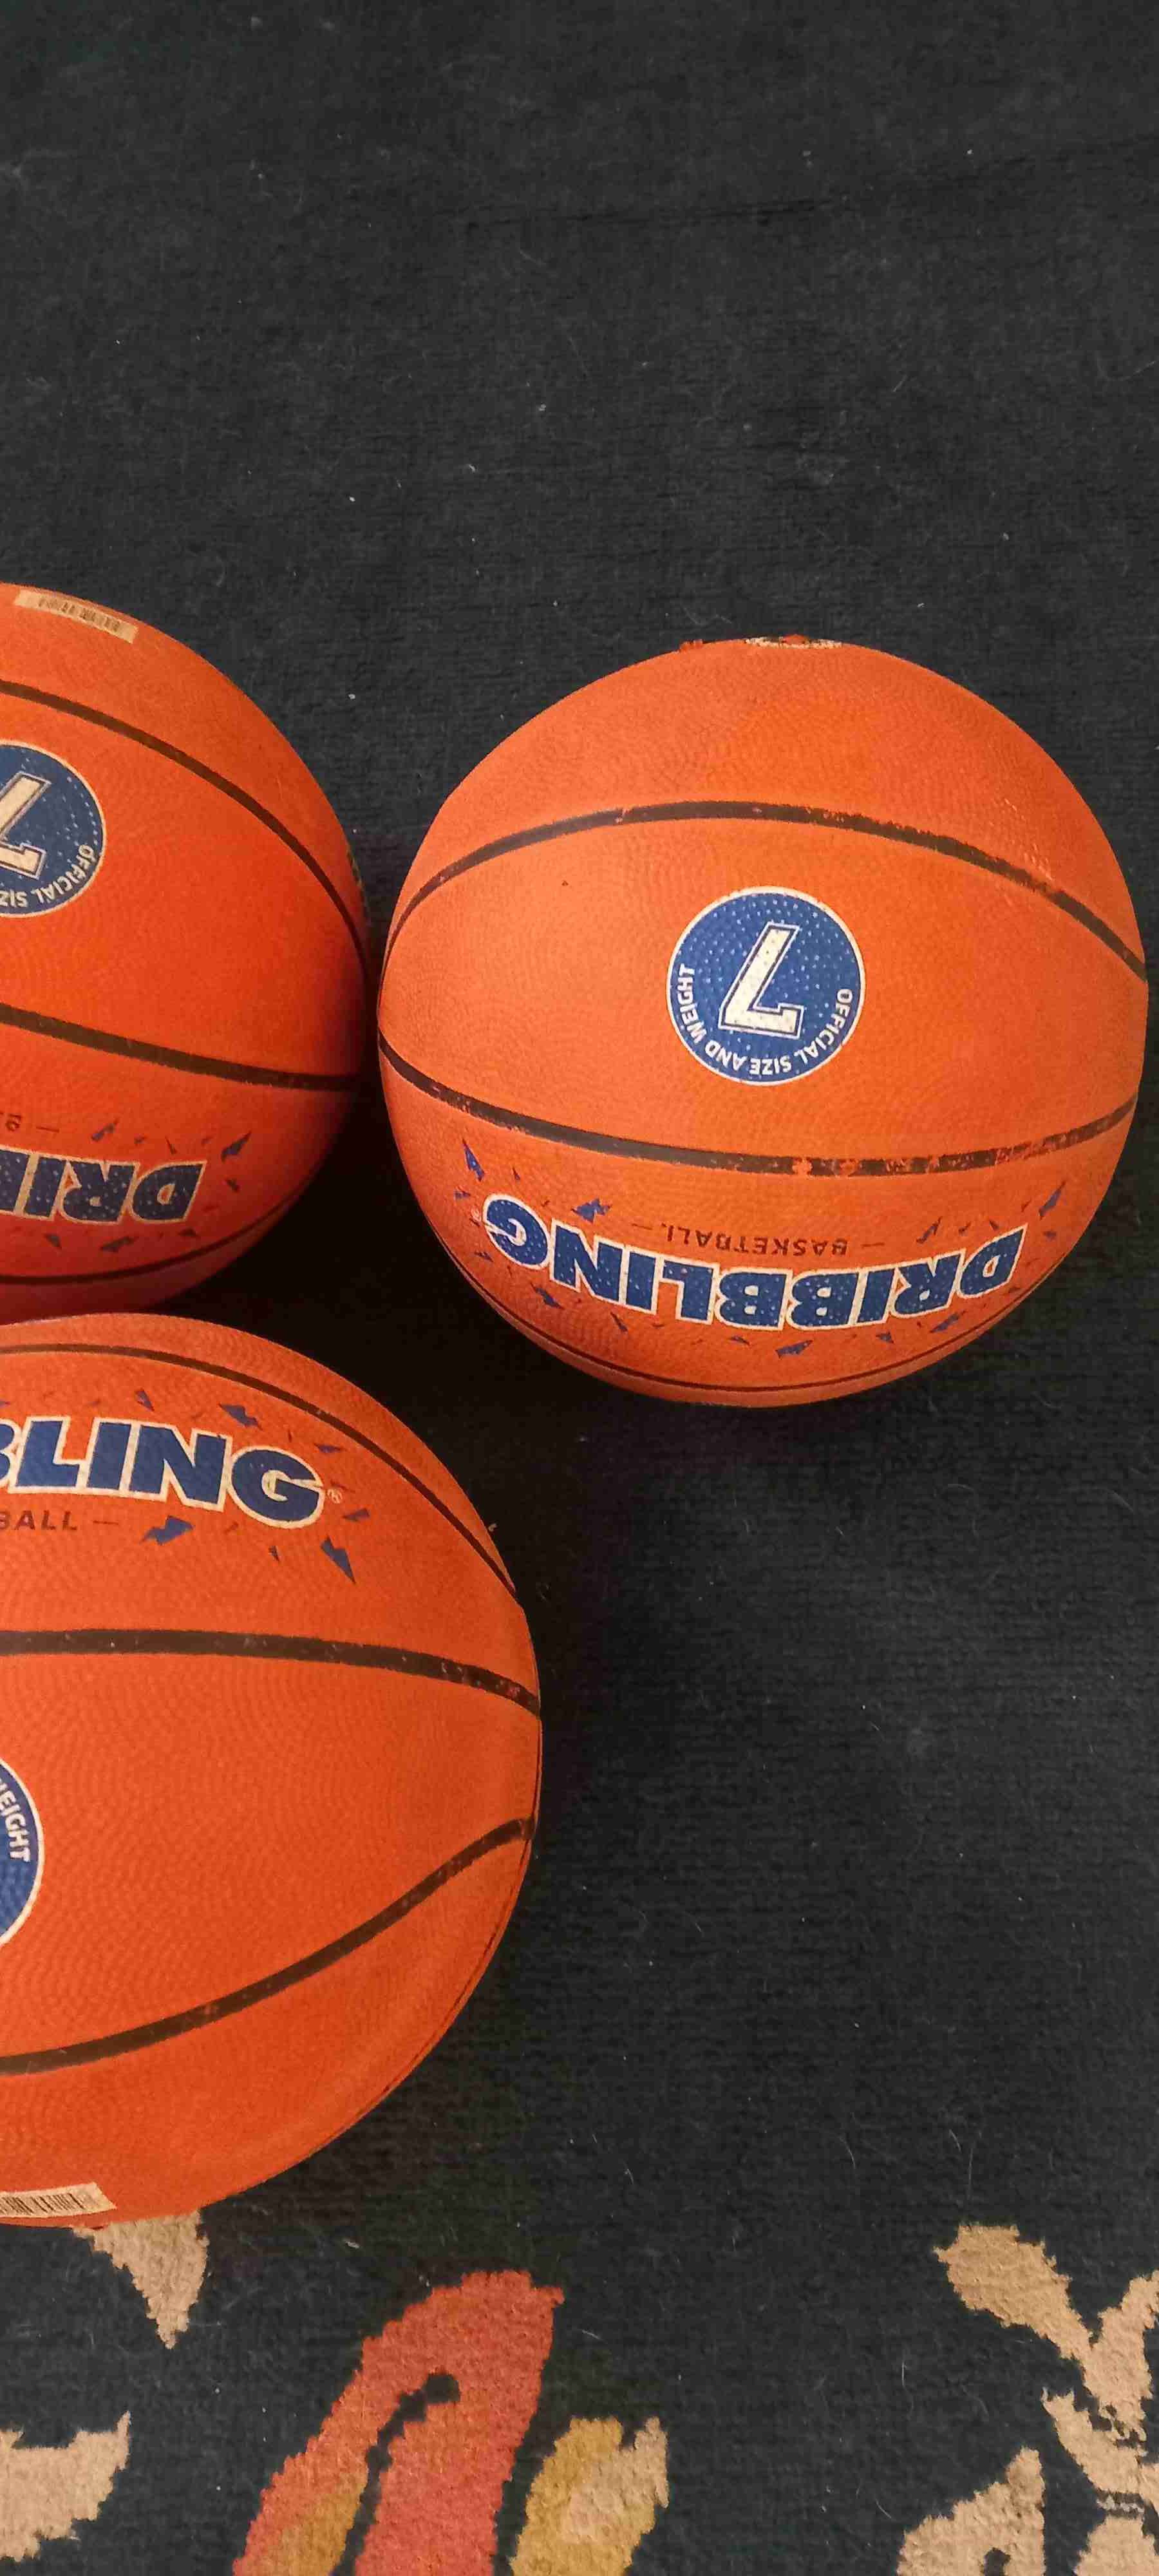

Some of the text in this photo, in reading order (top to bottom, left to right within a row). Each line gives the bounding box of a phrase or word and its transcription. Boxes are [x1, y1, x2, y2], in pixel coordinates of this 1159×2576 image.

[0, 772, 52, 880] 7
[31, 844, 95, 904] OFFICIAL
[677, 963, 853, 1075] OFFICIAL SIZE AND WEIGHT
[718, 922, 804, 1039] 7
[481, 1193, 1028, 1331] DRIBBLING
[661, 1222, 849, 1257] BASKETBALL
